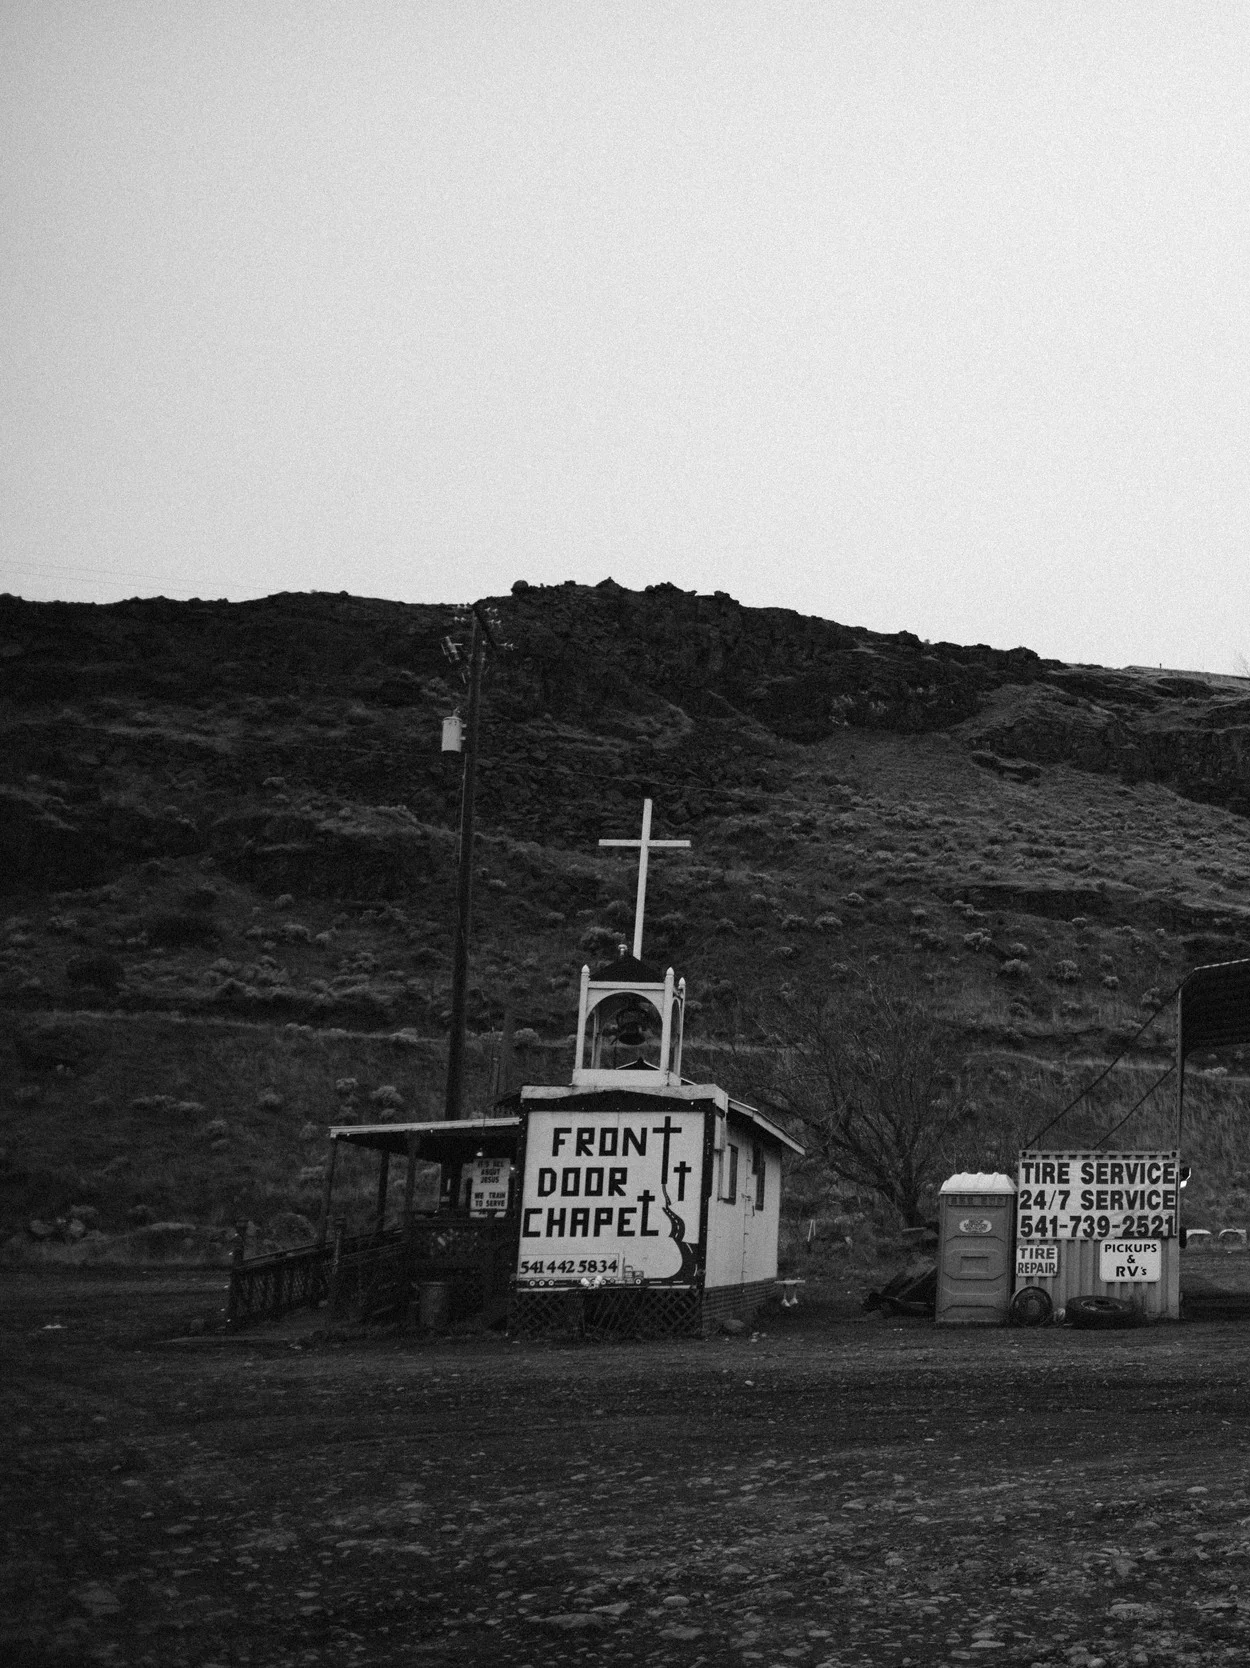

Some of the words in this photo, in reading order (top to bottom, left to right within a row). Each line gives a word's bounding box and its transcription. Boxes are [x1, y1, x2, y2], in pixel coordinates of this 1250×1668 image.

[1022, 1162, 1070, 1184] TIRE
[1080, 1162, 1176, 1184] SERVICE
[538, 1167, 628, 1197] DOOR
[1019, 1189, 1071, 1210] 24/7
[1080, 1189, 1176, 1210] SERVICE
[522, 1189, 659, 1237] CHAPEL
[1020, 1215, 1174, 1237] 541-739-2521
[1020, 1247, 1055, 1259] TIRE
[1104, 1243, 1157, 1253] PICKUPS
[1126, 1254, 1136, 1263] &
[520, 1260, 545, 1274] 541
[546, 1260, 575, 1273] 442
[577, 1259, 618, 1273] 5834
[1018, 1262, 1056, 1274] REPAIR
[1115, 1266, 1147, 1277] RV's
